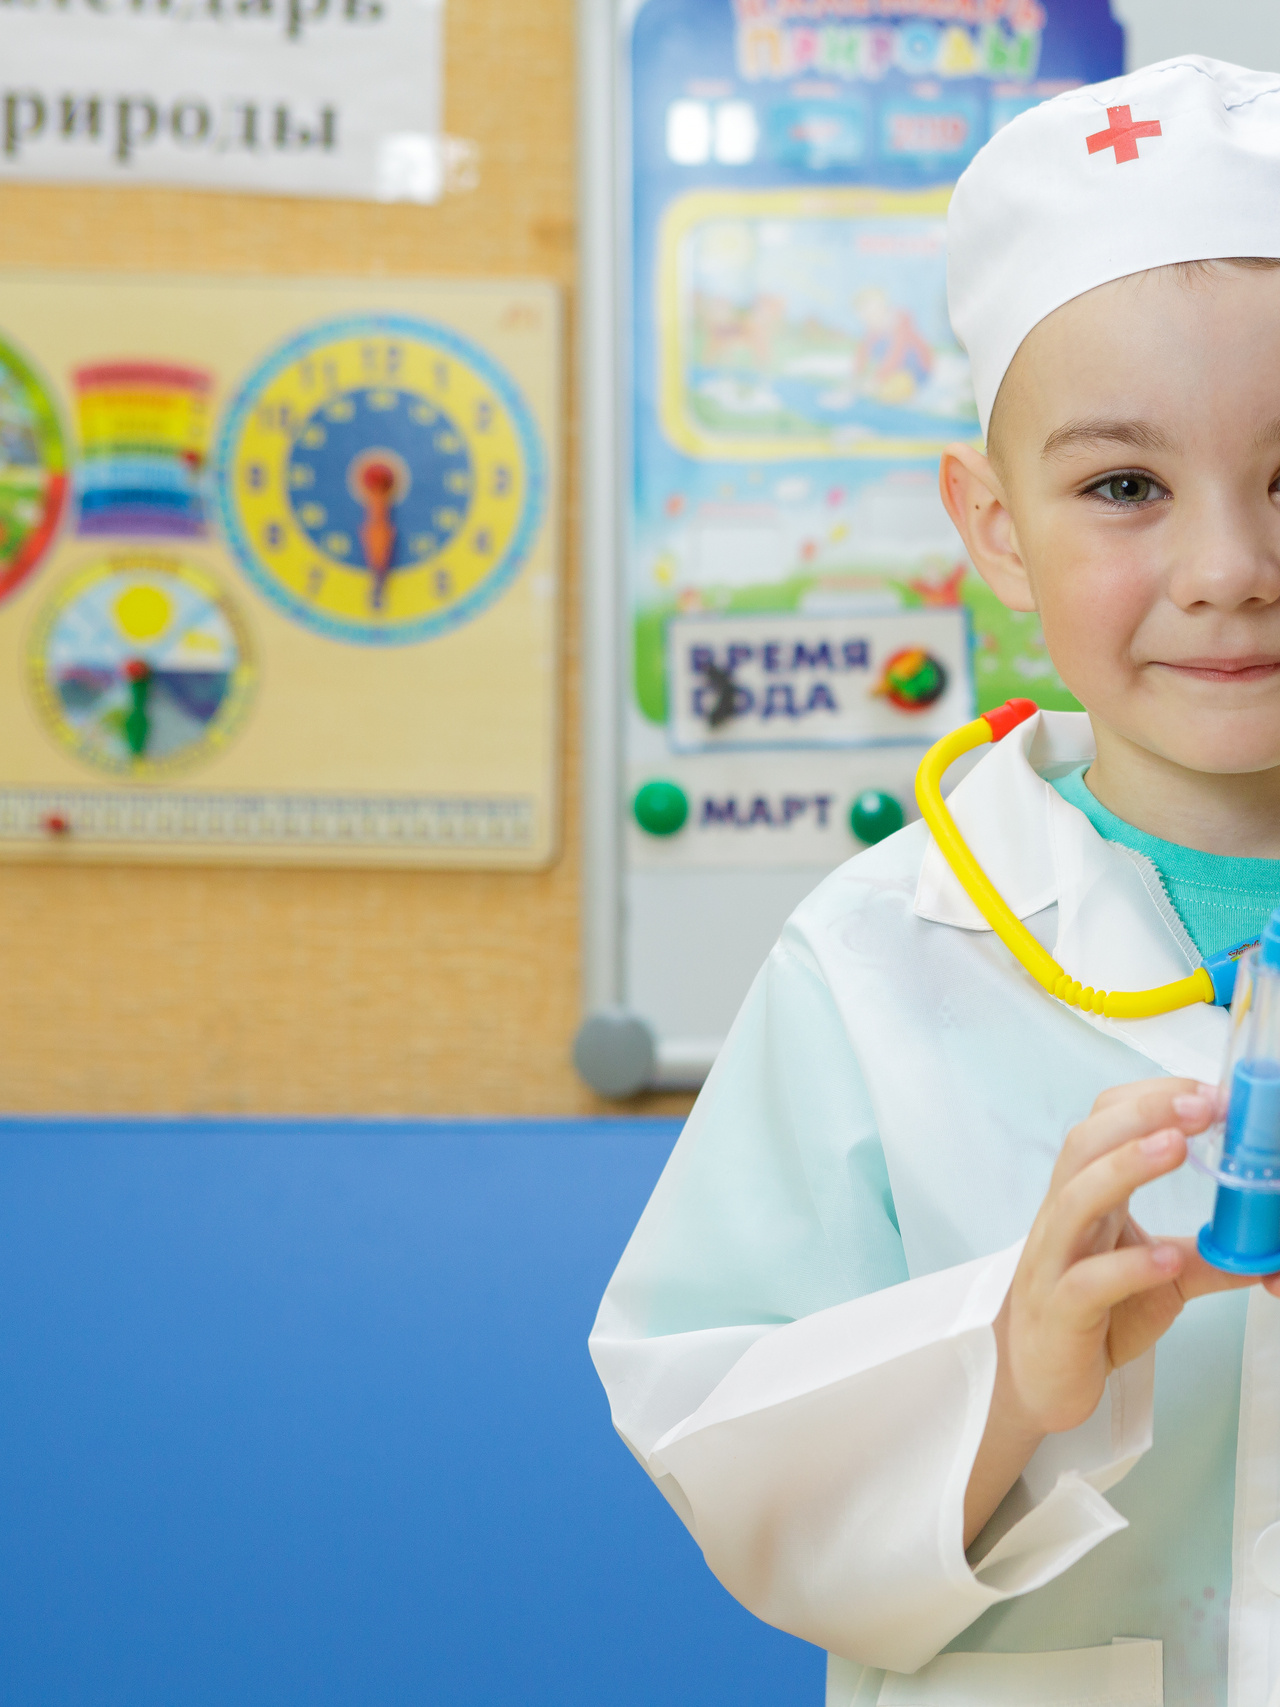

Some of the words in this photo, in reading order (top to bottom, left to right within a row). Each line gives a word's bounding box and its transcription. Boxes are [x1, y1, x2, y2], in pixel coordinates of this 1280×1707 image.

[738, 20, 1042, 80] ПРИРОДЫ
[689, 638, 870, 676] ВРЕМЯ
[701, 795, 833, 828] МАРТ
